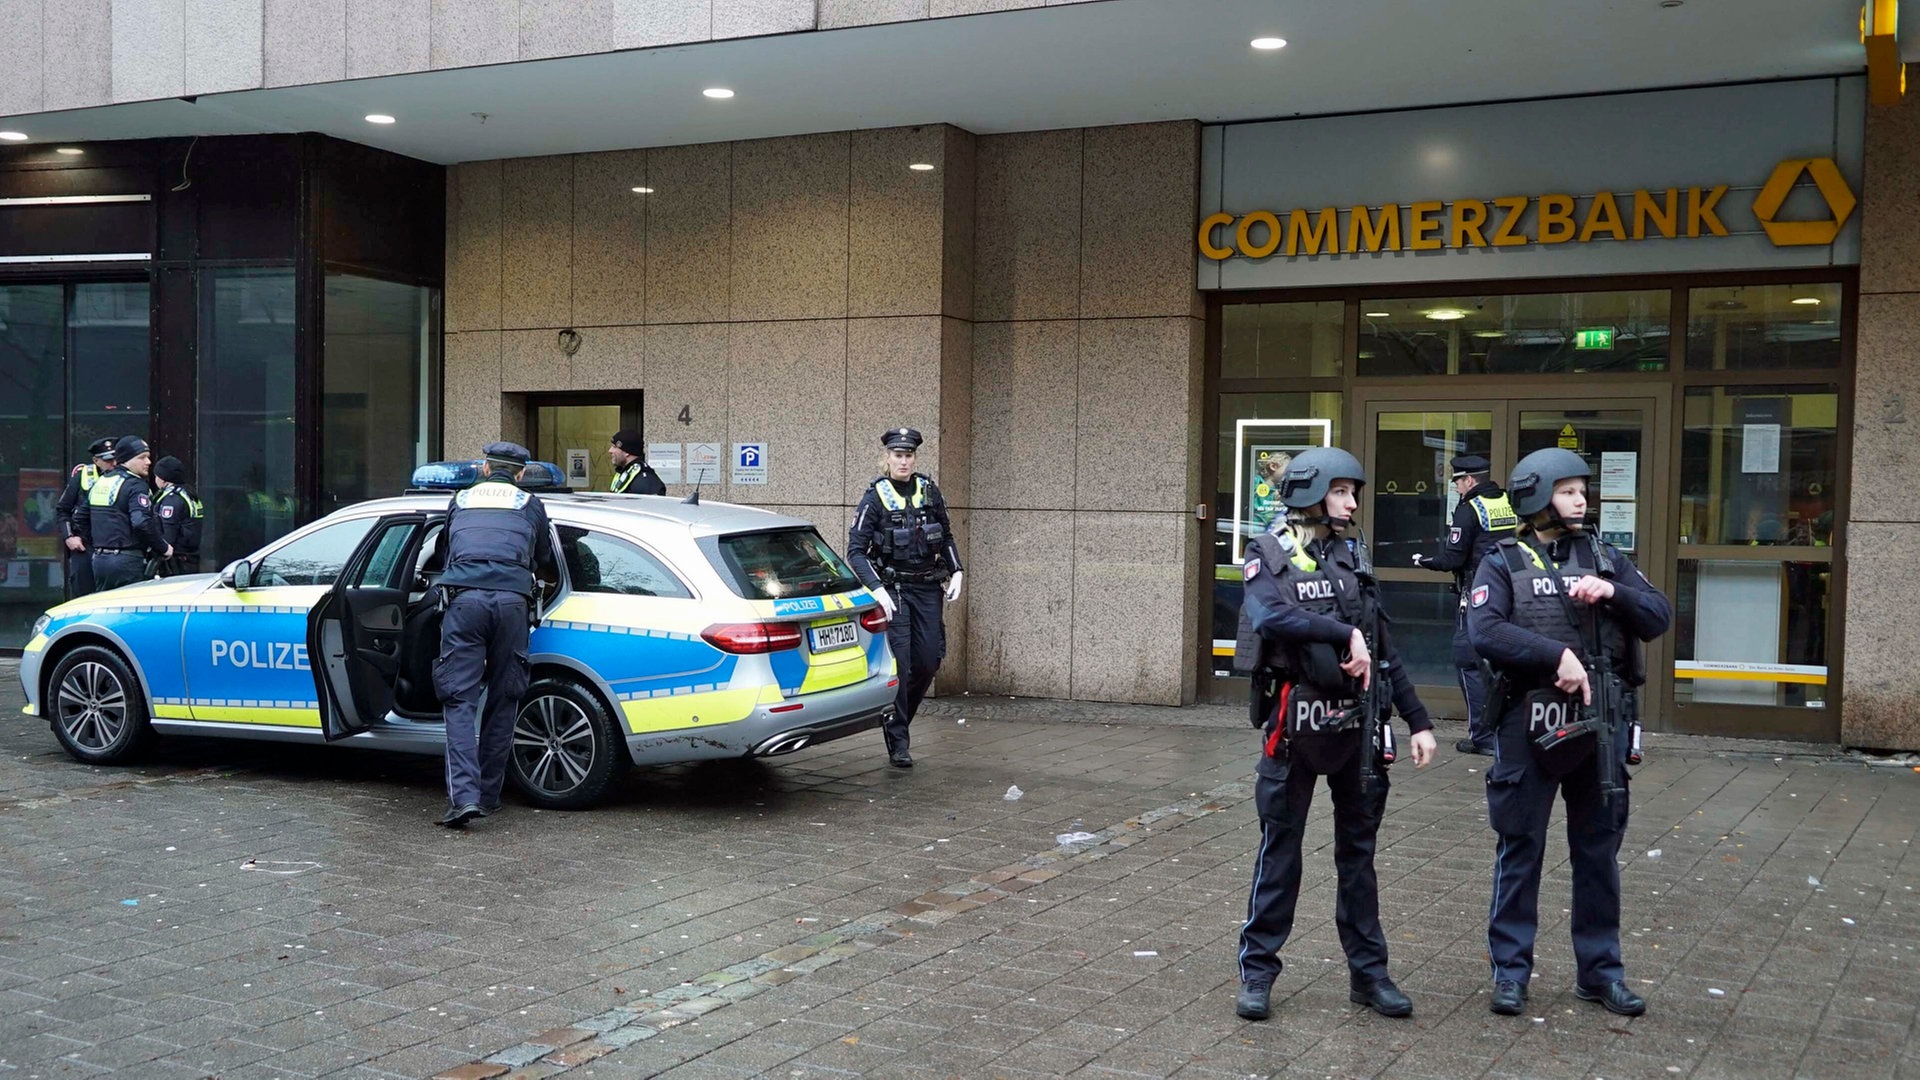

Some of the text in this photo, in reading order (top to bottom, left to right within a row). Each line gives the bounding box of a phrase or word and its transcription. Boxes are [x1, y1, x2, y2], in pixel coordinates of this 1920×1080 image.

[1198, 184, 1729, 261] COMMERZBANK
[678, 404, 692, 426] 4
[1877, 395, 1907, 424] 2
[746, 452, 755, 466] P
[472, 486, 513, 498] POLIZEI
[1489, 506, 1512, 518] POLIZE
[784, 600, 818, 612] POLIZEI
[818, 625, 854, 646] HH 7180
[211, 639, 312, 671] POLIZE
